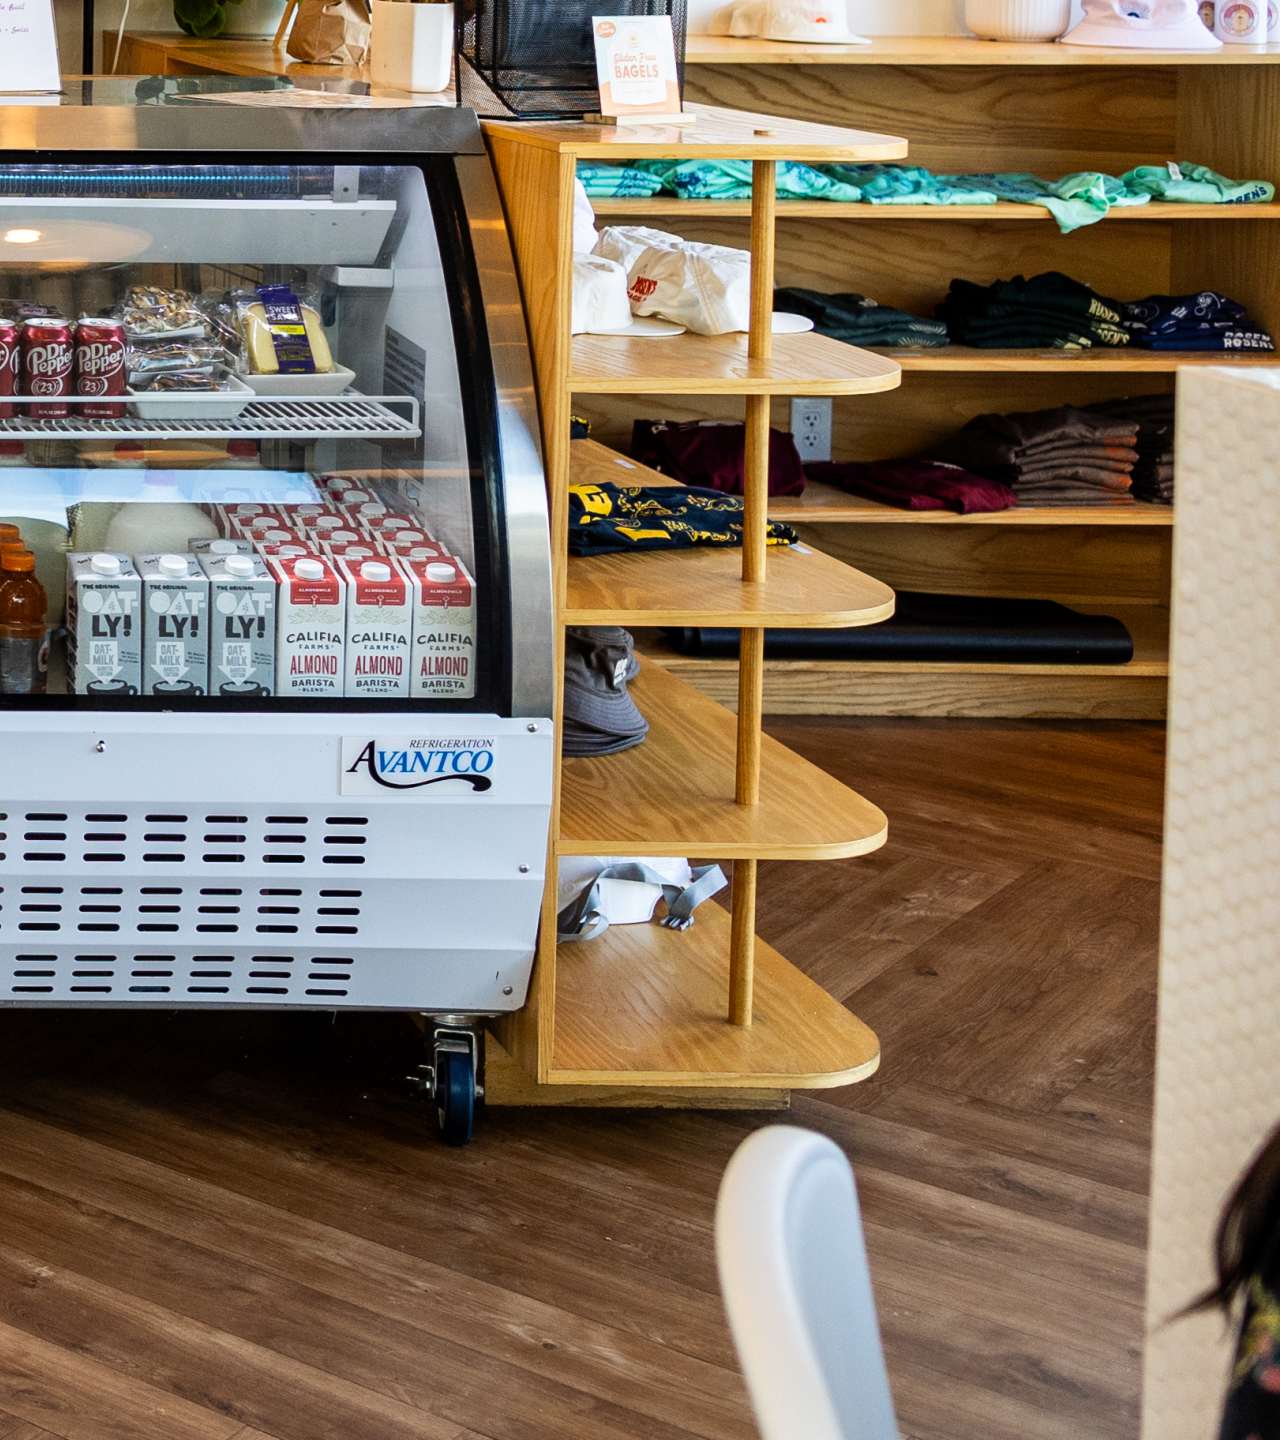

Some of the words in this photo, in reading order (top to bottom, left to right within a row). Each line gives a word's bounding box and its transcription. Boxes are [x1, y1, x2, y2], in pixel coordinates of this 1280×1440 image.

[615, 64, 659, 78] BAGELS
[47, 343, 66, 359] Dr
[90, 343, 112, 359] Dr
[29, 347, 73, 375] Pepper
[79, 348, 120, 375] Pepper
[40, 381, 53, 393] 23
[85, 381, 97, 393] 23
[92, 615, 132, 638] LY!
[158, 616, 199, 638] LY!
[225, 616, 266, 639] LY!
[286, 632, 342, 645] CALIFIA
[351, 632, 407, 645] CALIFIA
[417, 633, 473, 646] CALIFIA
[92, 655, 114, 665] MILK
[159, 655, 181, 666] MILK
[226, 656, 247, 667] MILK
[290, 655, 337, 675] ALMOND
[355, 656, 402, 676] ALMOND
[420, 657, 468, 677] ALMOND
[291, 680, 335, 688] BARISTA
[356, 680, 399, 689] BARISTA
[422, 681, 465, 689] BARISTA
[409, 738, 494, 748] REFRIGERATION
[345, 740, 494, 783] AVANTCO
